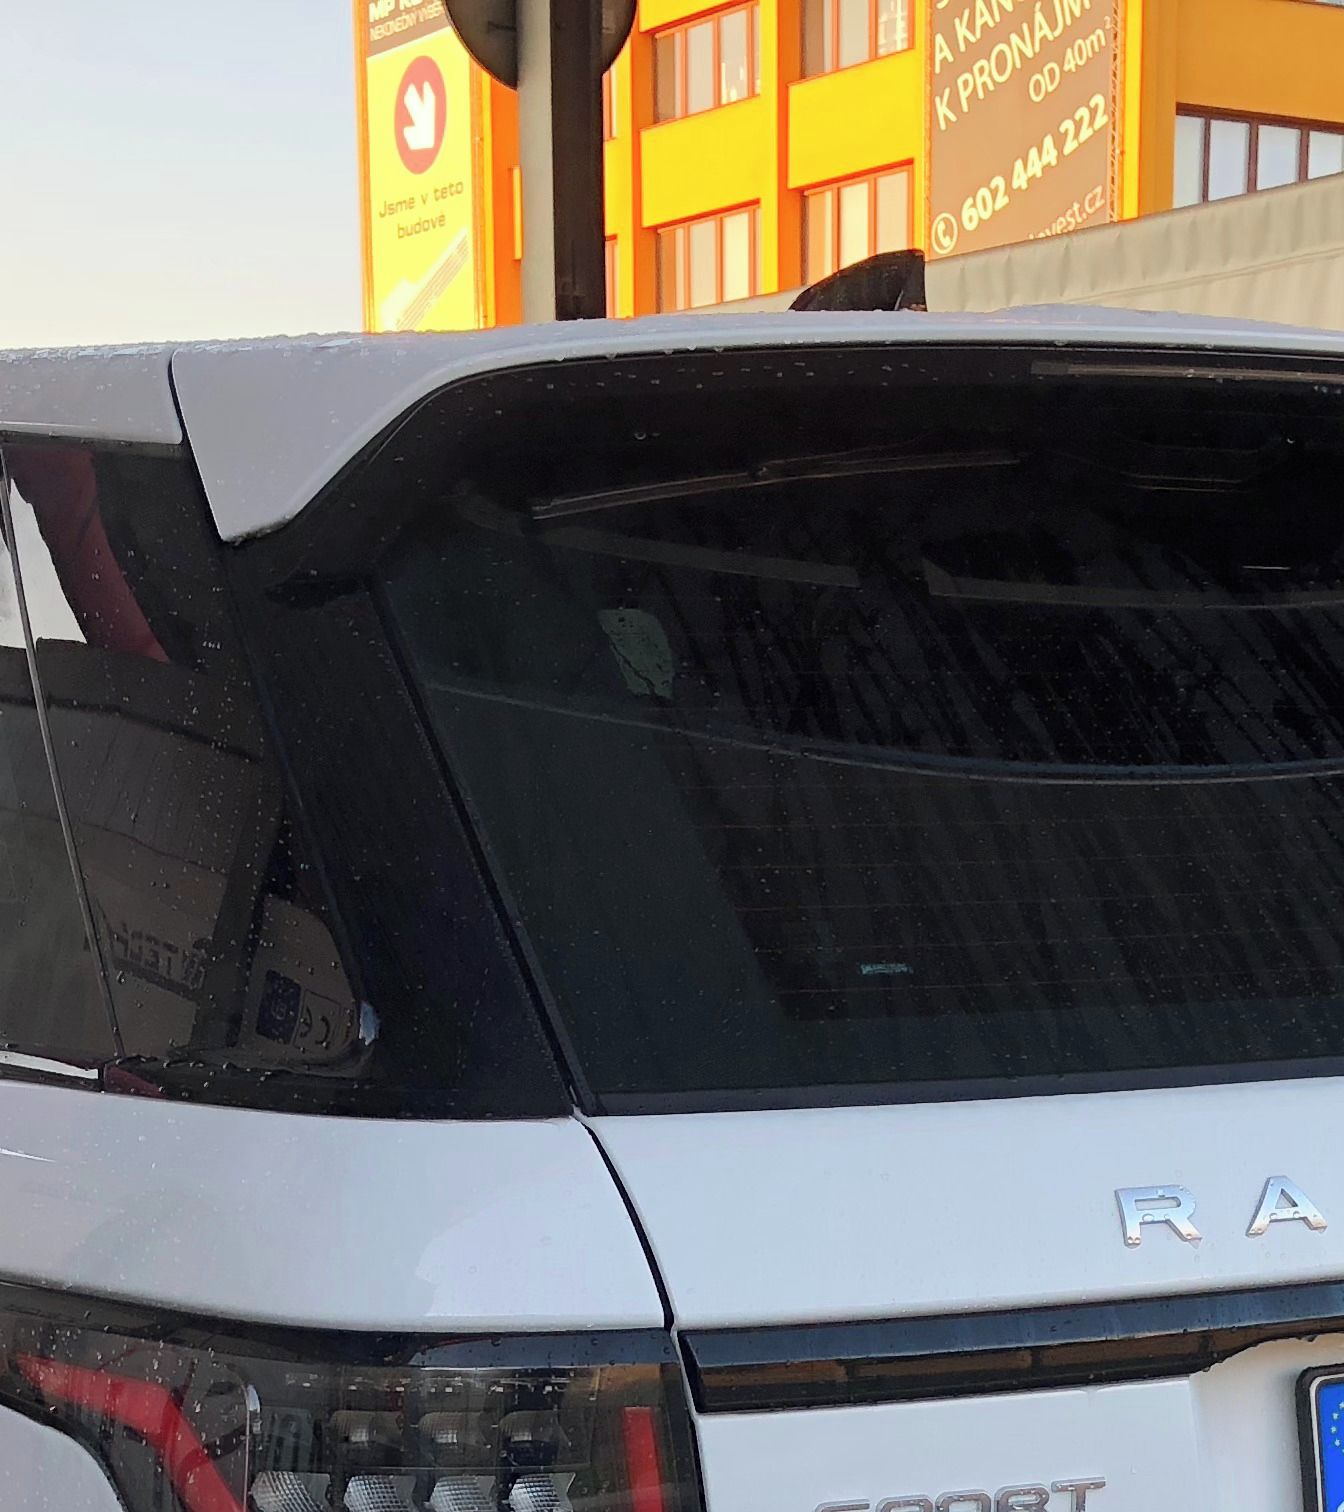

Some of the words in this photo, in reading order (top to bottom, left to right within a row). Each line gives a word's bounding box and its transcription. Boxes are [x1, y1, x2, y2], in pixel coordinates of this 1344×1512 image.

[935, 33, 954, 74] A
[1029, 62, 1060, 102] OD
[935, 88, 957, 130] K
[961, 176, 1009, 231] 602
[1012, 134, 1058, 190] 444
[1059, 93, 1109, 156] 222
[379, 196, 416, 219] Jsme
[421, 194, 428, 206] v
